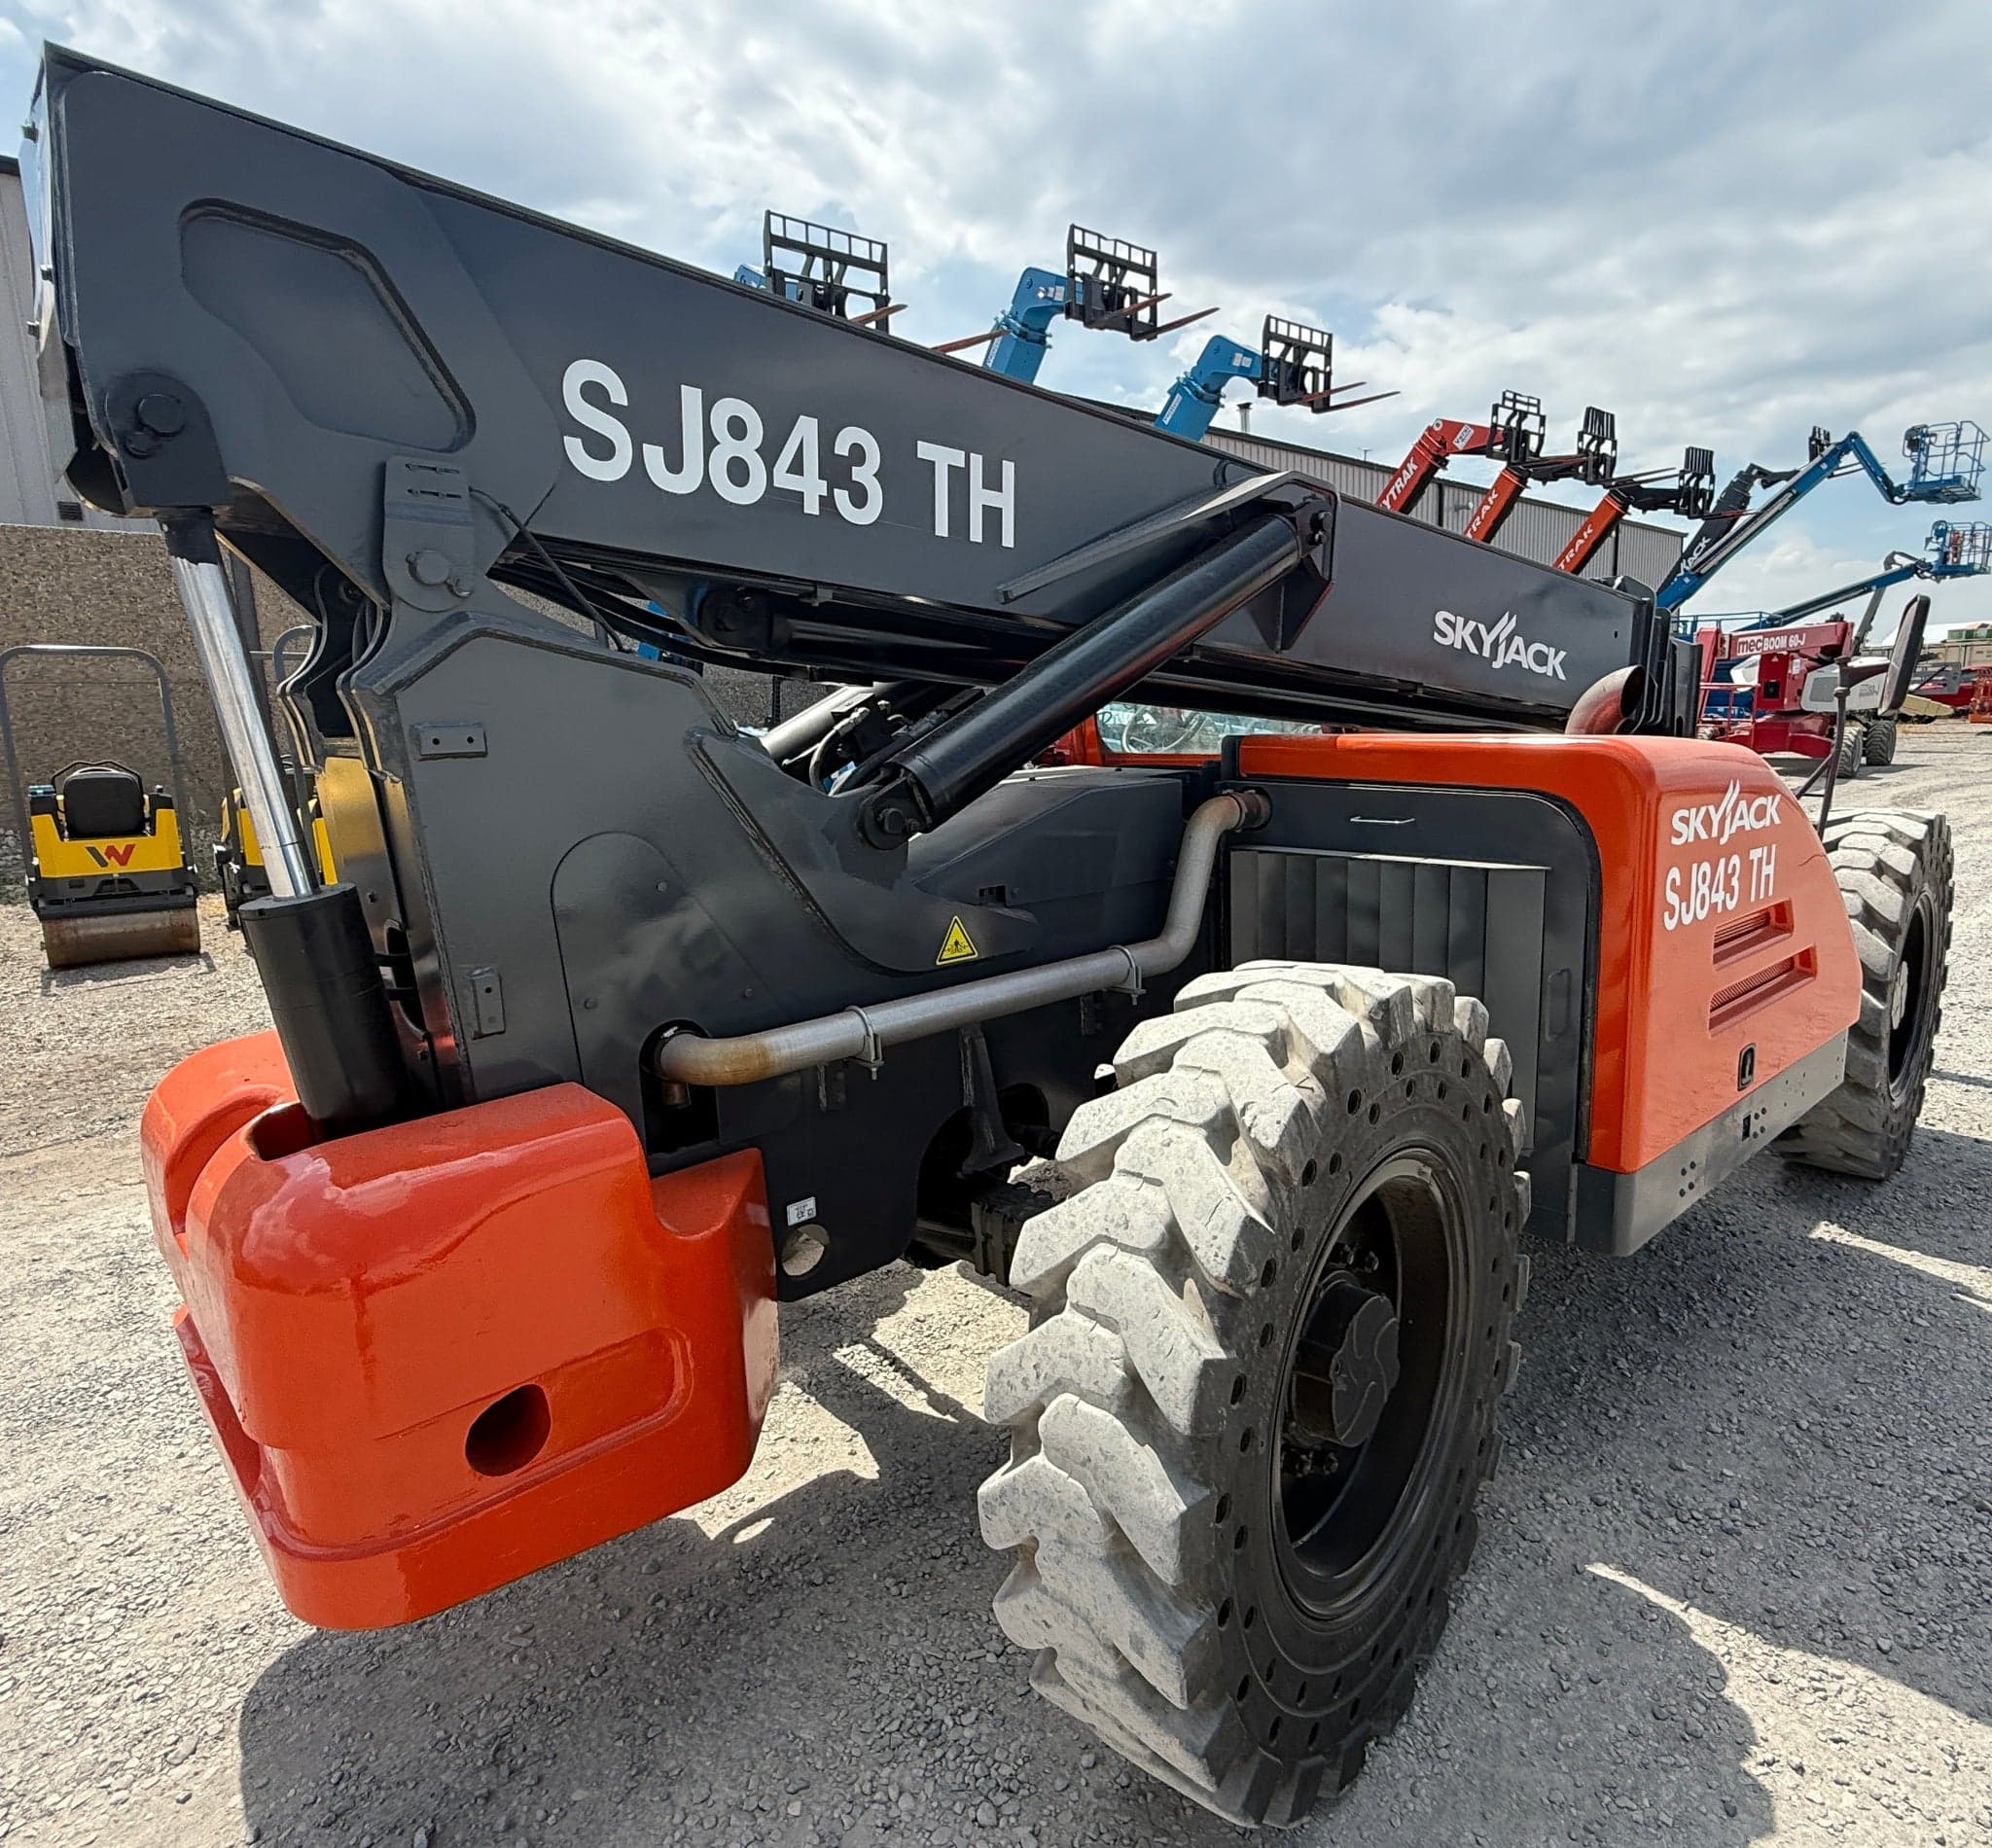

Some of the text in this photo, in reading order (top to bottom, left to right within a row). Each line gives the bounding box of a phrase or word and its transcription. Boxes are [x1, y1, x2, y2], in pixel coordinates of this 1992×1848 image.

[562, 358, 1015, 549] SJ843 TH
[1433, 611, 1567, 681] SKYJACK
[1671, 778, 1781, 845] SKYJACK
[1663, 844, 1777, 931] SJ843 TH
